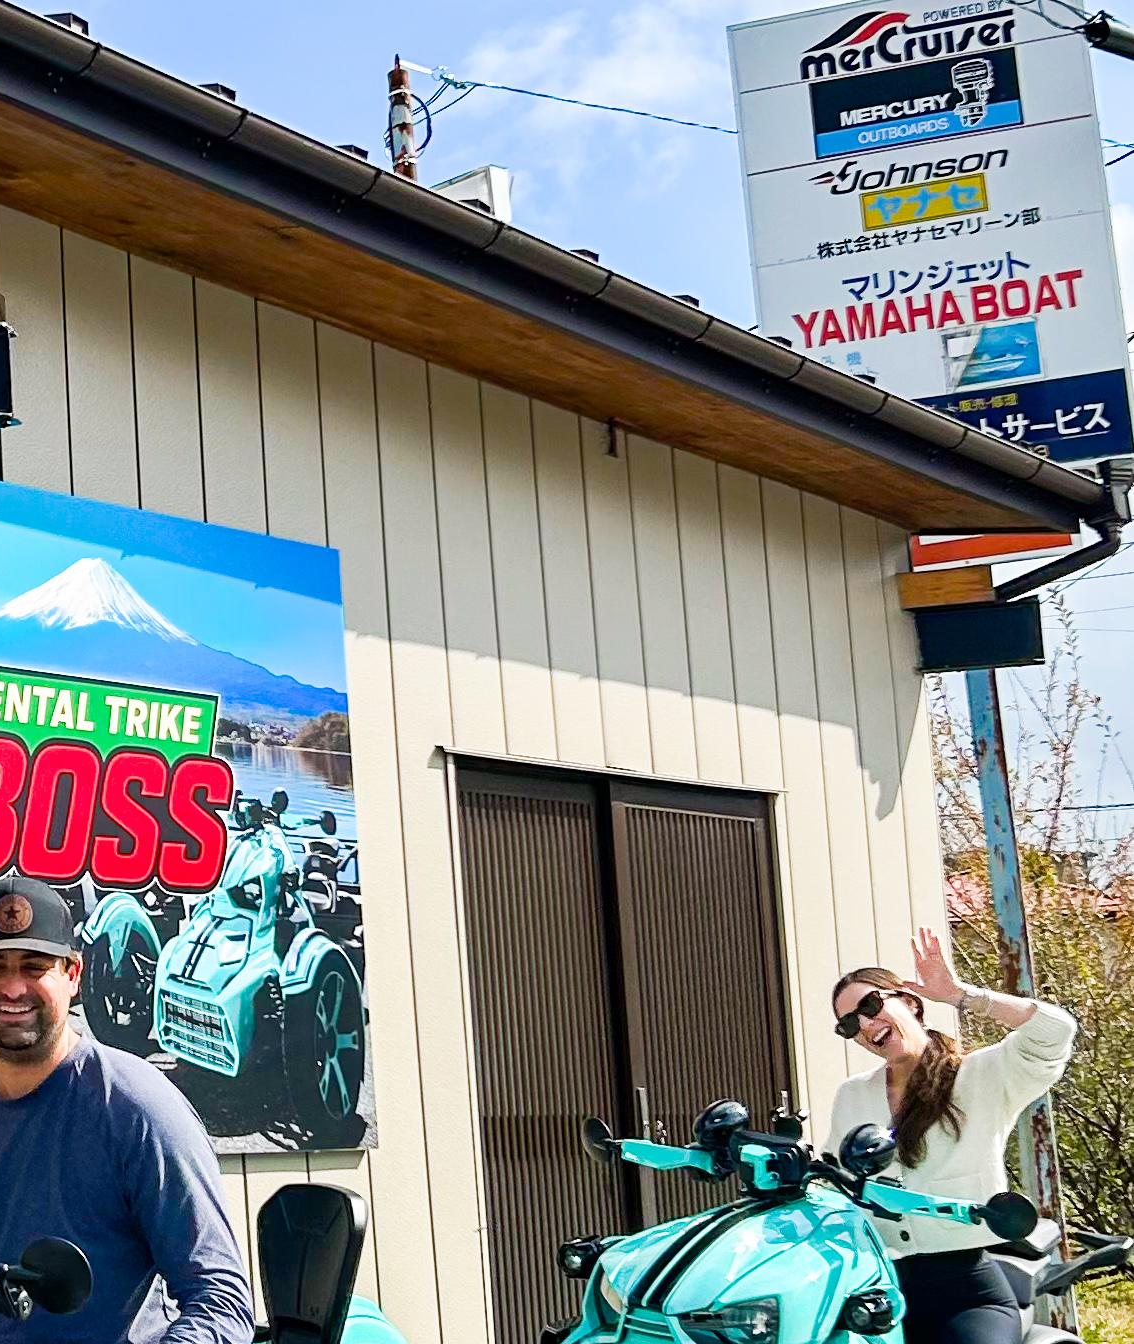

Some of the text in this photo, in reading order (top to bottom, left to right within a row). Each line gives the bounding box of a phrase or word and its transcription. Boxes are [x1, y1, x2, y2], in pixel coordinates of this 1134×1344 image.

[923, 0, 1003, 23] POWERED BY
[839, 92, 952, 127] MERCURY
[857, 117, 949, 144] OUTBOARDS
[829, 149, 1008, 195] Johnson
[867, 182, 982, 222] ヤナセ
[817, 206, 1041, 260] 株式会社ヤナセマリーン部
[841, 251, 1031, 301] マリンジェット
[792, 269, 1083, 349] YAMAHA BOAT
[104, 695, 204, 744] TRIKE
